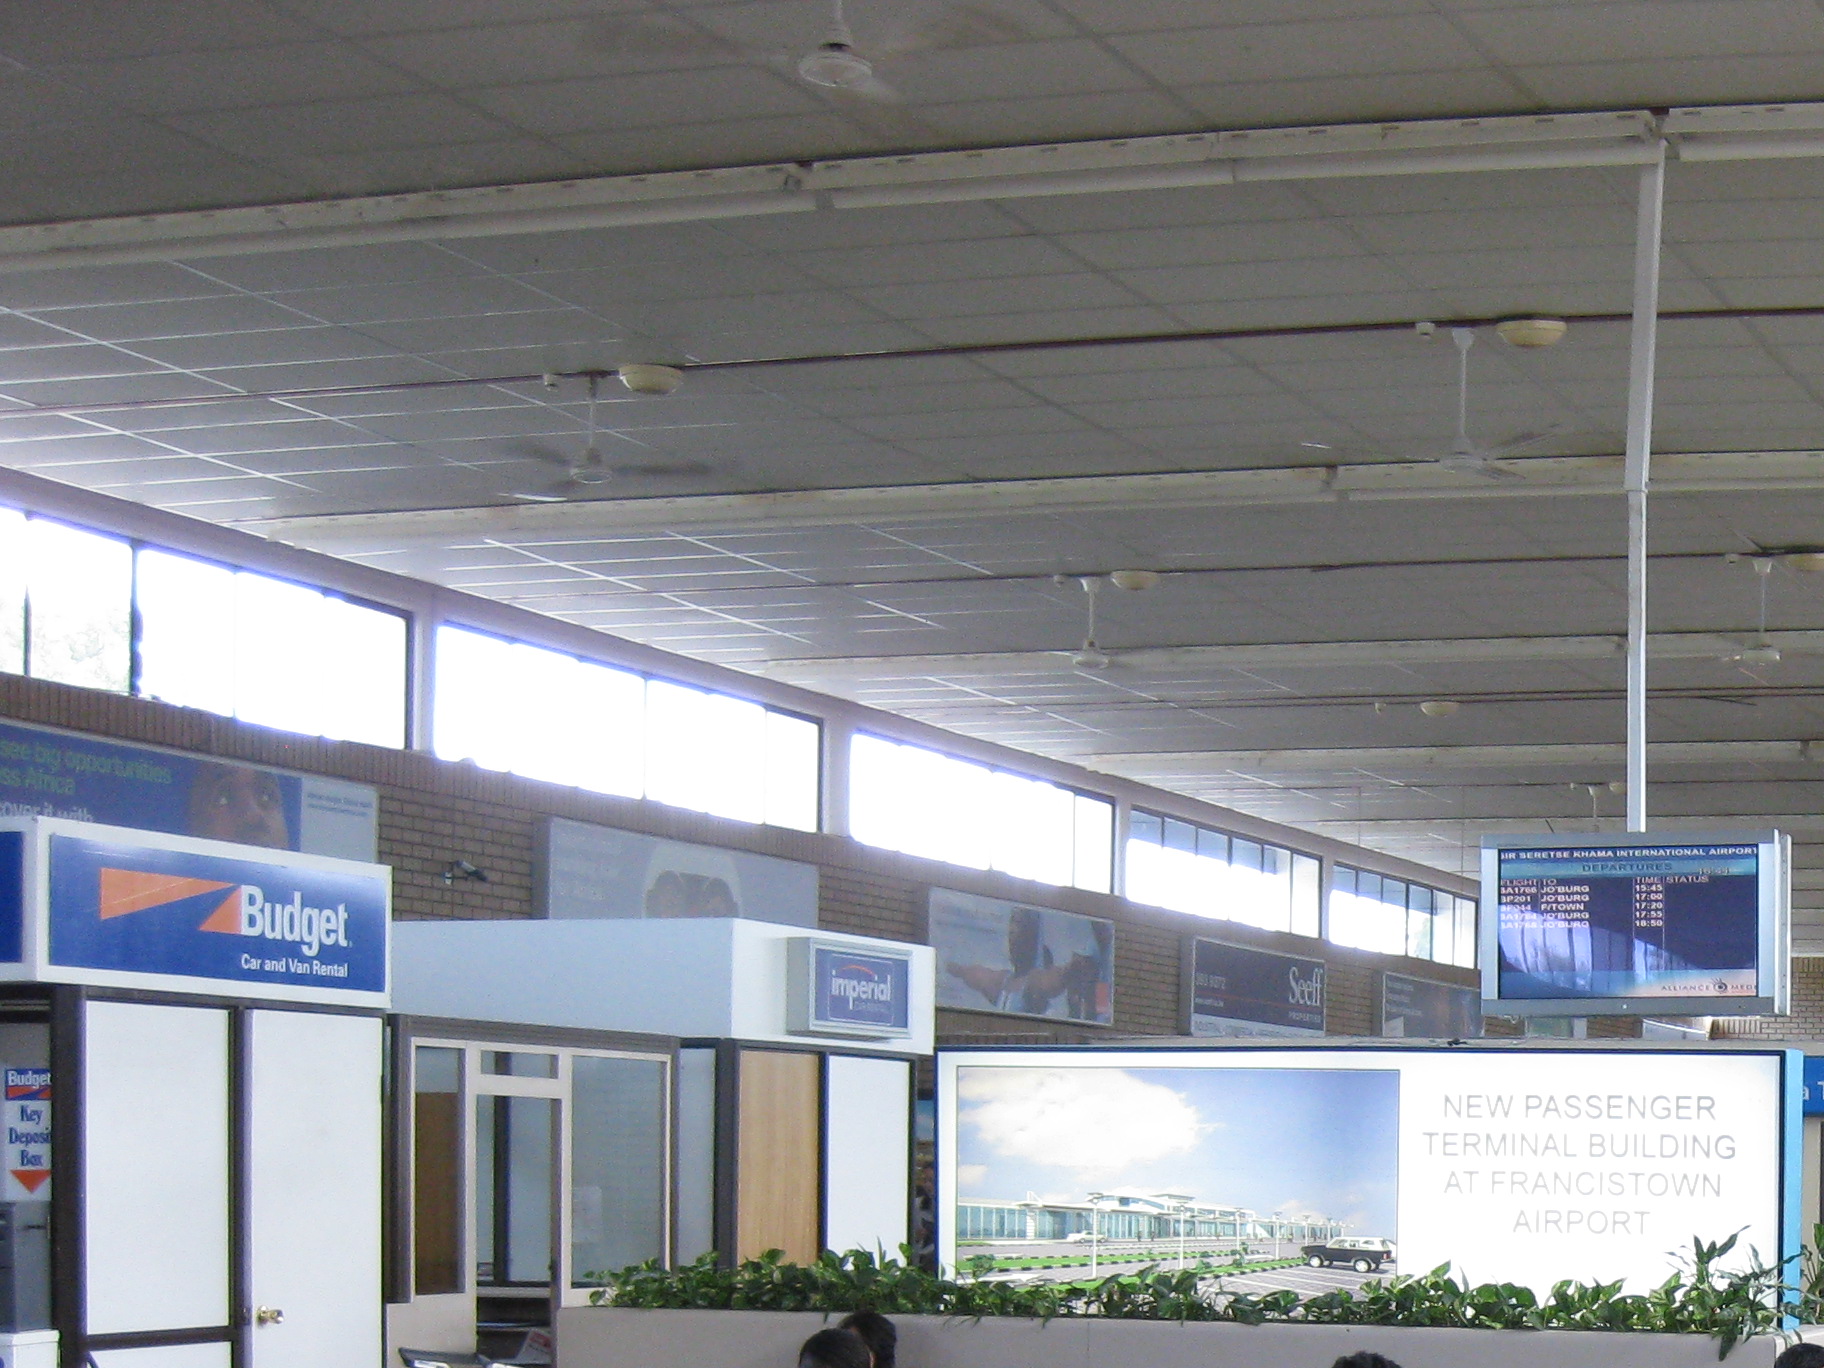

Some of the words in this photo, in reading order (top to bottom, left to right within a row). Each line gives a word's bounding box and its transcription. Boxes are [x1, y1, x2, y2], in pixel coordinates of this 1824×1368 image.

[1519, 851, 1569, 859] SERETSE
[1573, 850, 1614, 858] KHAMA
[1616, 848, 1706, 857] INTERNATIONAL
[1582, 863, 1672, 873] DEPARTURES
[1542, 878, 1557, 886] TO
[1636, 876, 1659, 884] TIME
[1666, 875, 1709, 883] STATUS
[241, 885, 349, 957] Budget
[241, 954, 262, 970] Car
[264, 957, 286, 972] and
[289, 958, 310, 975] Van
[313, 960, 348, 977] Rental
[831, 969, 891, 1011] imperial
[1289, 966, 1323, 1006] Seeff
[8, 1071, 51, 1088] Budget
[20, 1105, 43, 1125] Key
[1443, 1095, 1514, 1118] NEW
[1525, 1095, 1716, 1120] PASSENGER
[9, 1127, 51, 1147] Deposi
[1422, 1132, 1578, 1158] TERMINAL
[1589, 1133, 1736, 1160] BUILDING
[21, 1149, 43, 1167] Box
[1443, 1171, 1479, 1194] AT
[1491, 1171, 1721, 1197] FRANCISTOWN
[1513, 1210, 1651, 1235] AIRPORT
